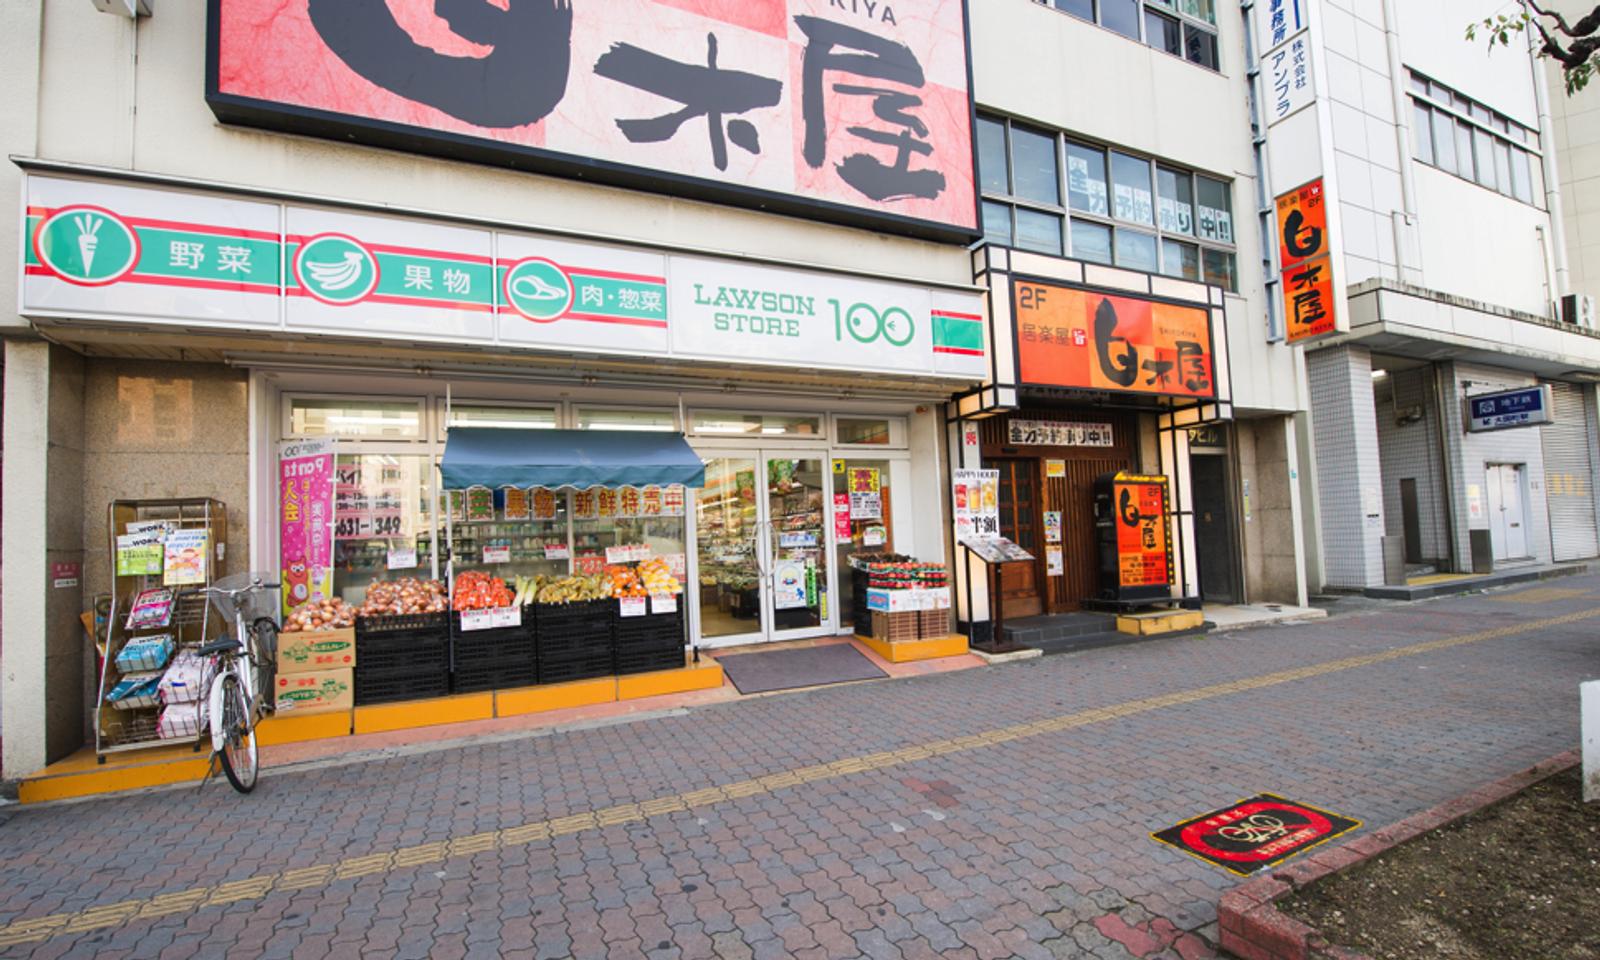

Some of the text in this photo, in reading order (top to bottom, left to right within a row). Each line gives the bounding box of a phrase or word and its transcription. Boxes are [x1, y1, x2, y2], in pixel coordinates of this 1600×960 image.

[1293, 40, 1306, 90] 株式会社
[169, 240, 252, 274] 野菜
[404, 264, 471, 296] 果物
[1020, 286, 1047, 310] 2F
[694, 284, 915, 347] LAWSON 100
[714, 313, 800, 337] STORE
